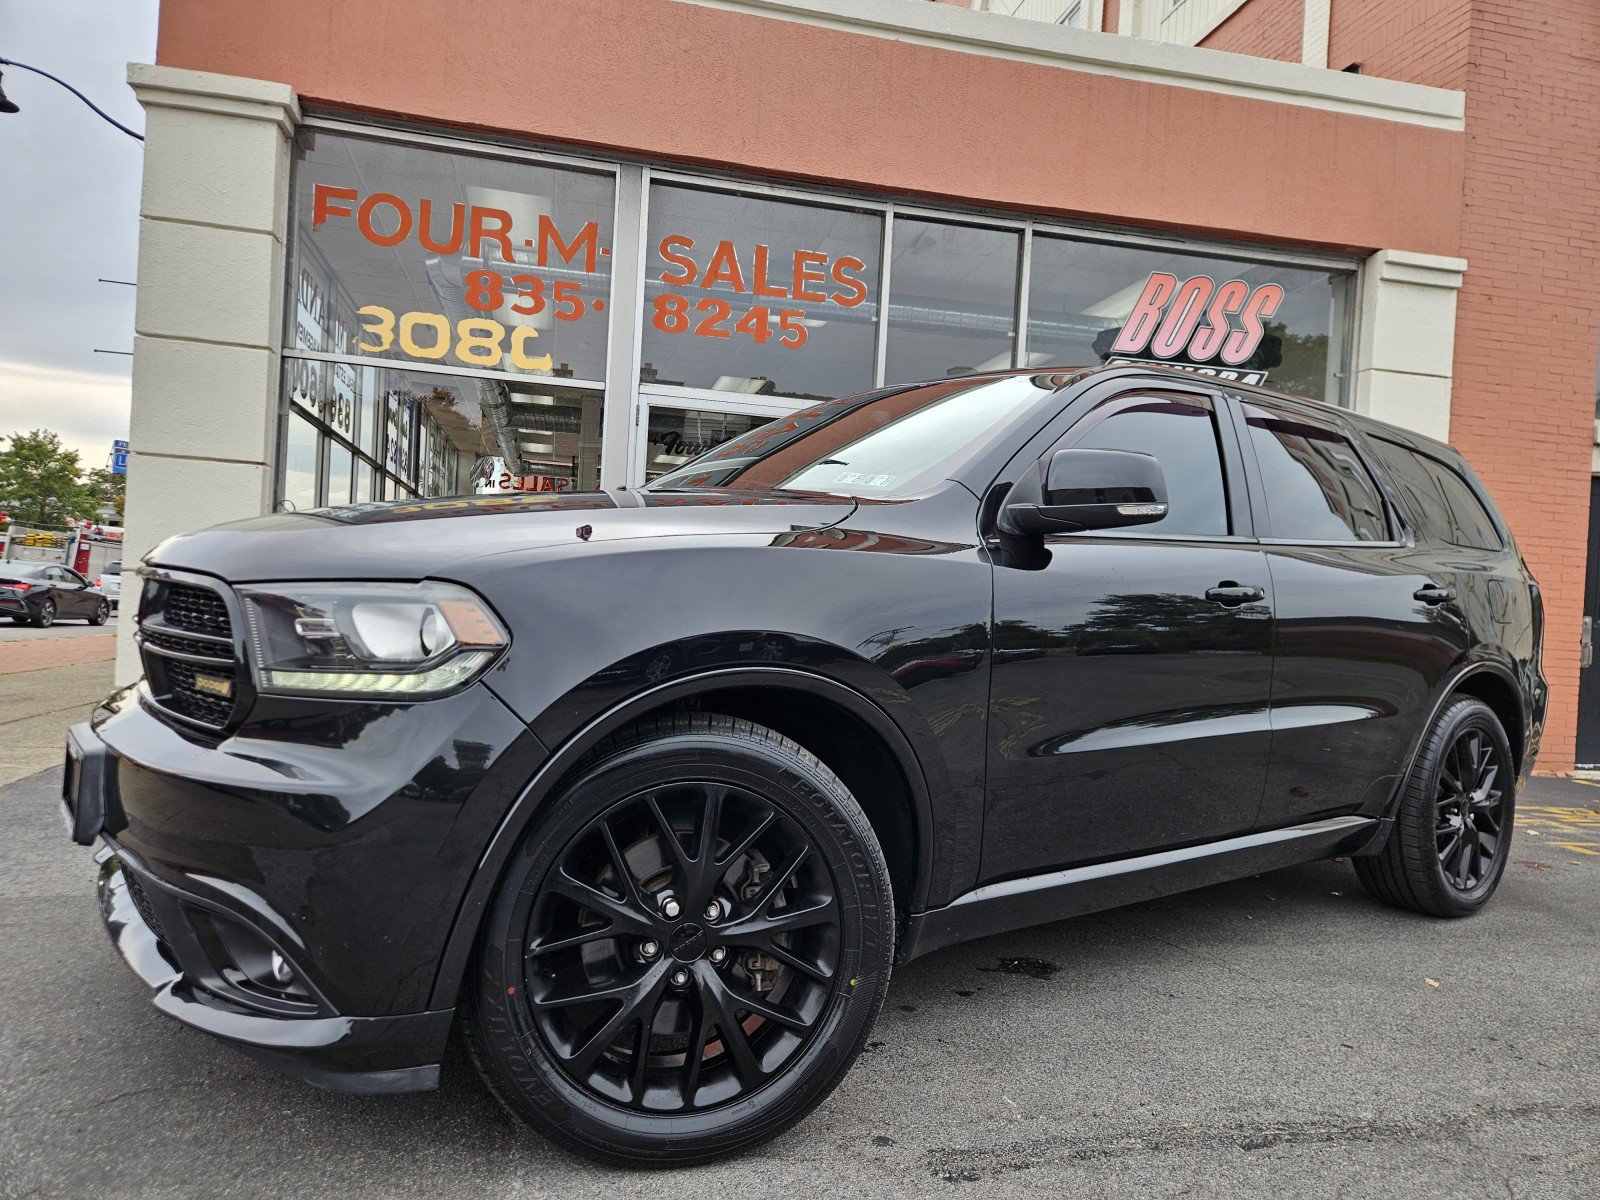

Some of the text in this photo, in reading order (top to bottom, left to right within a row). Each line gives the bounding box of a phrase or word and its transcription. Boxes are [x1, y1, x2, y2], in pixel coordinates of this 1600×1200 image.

[659, 234, 868, 308] SALES
[652, 293, 809, 349] 8245
[1110, 271, 1285, 366] BOSS
